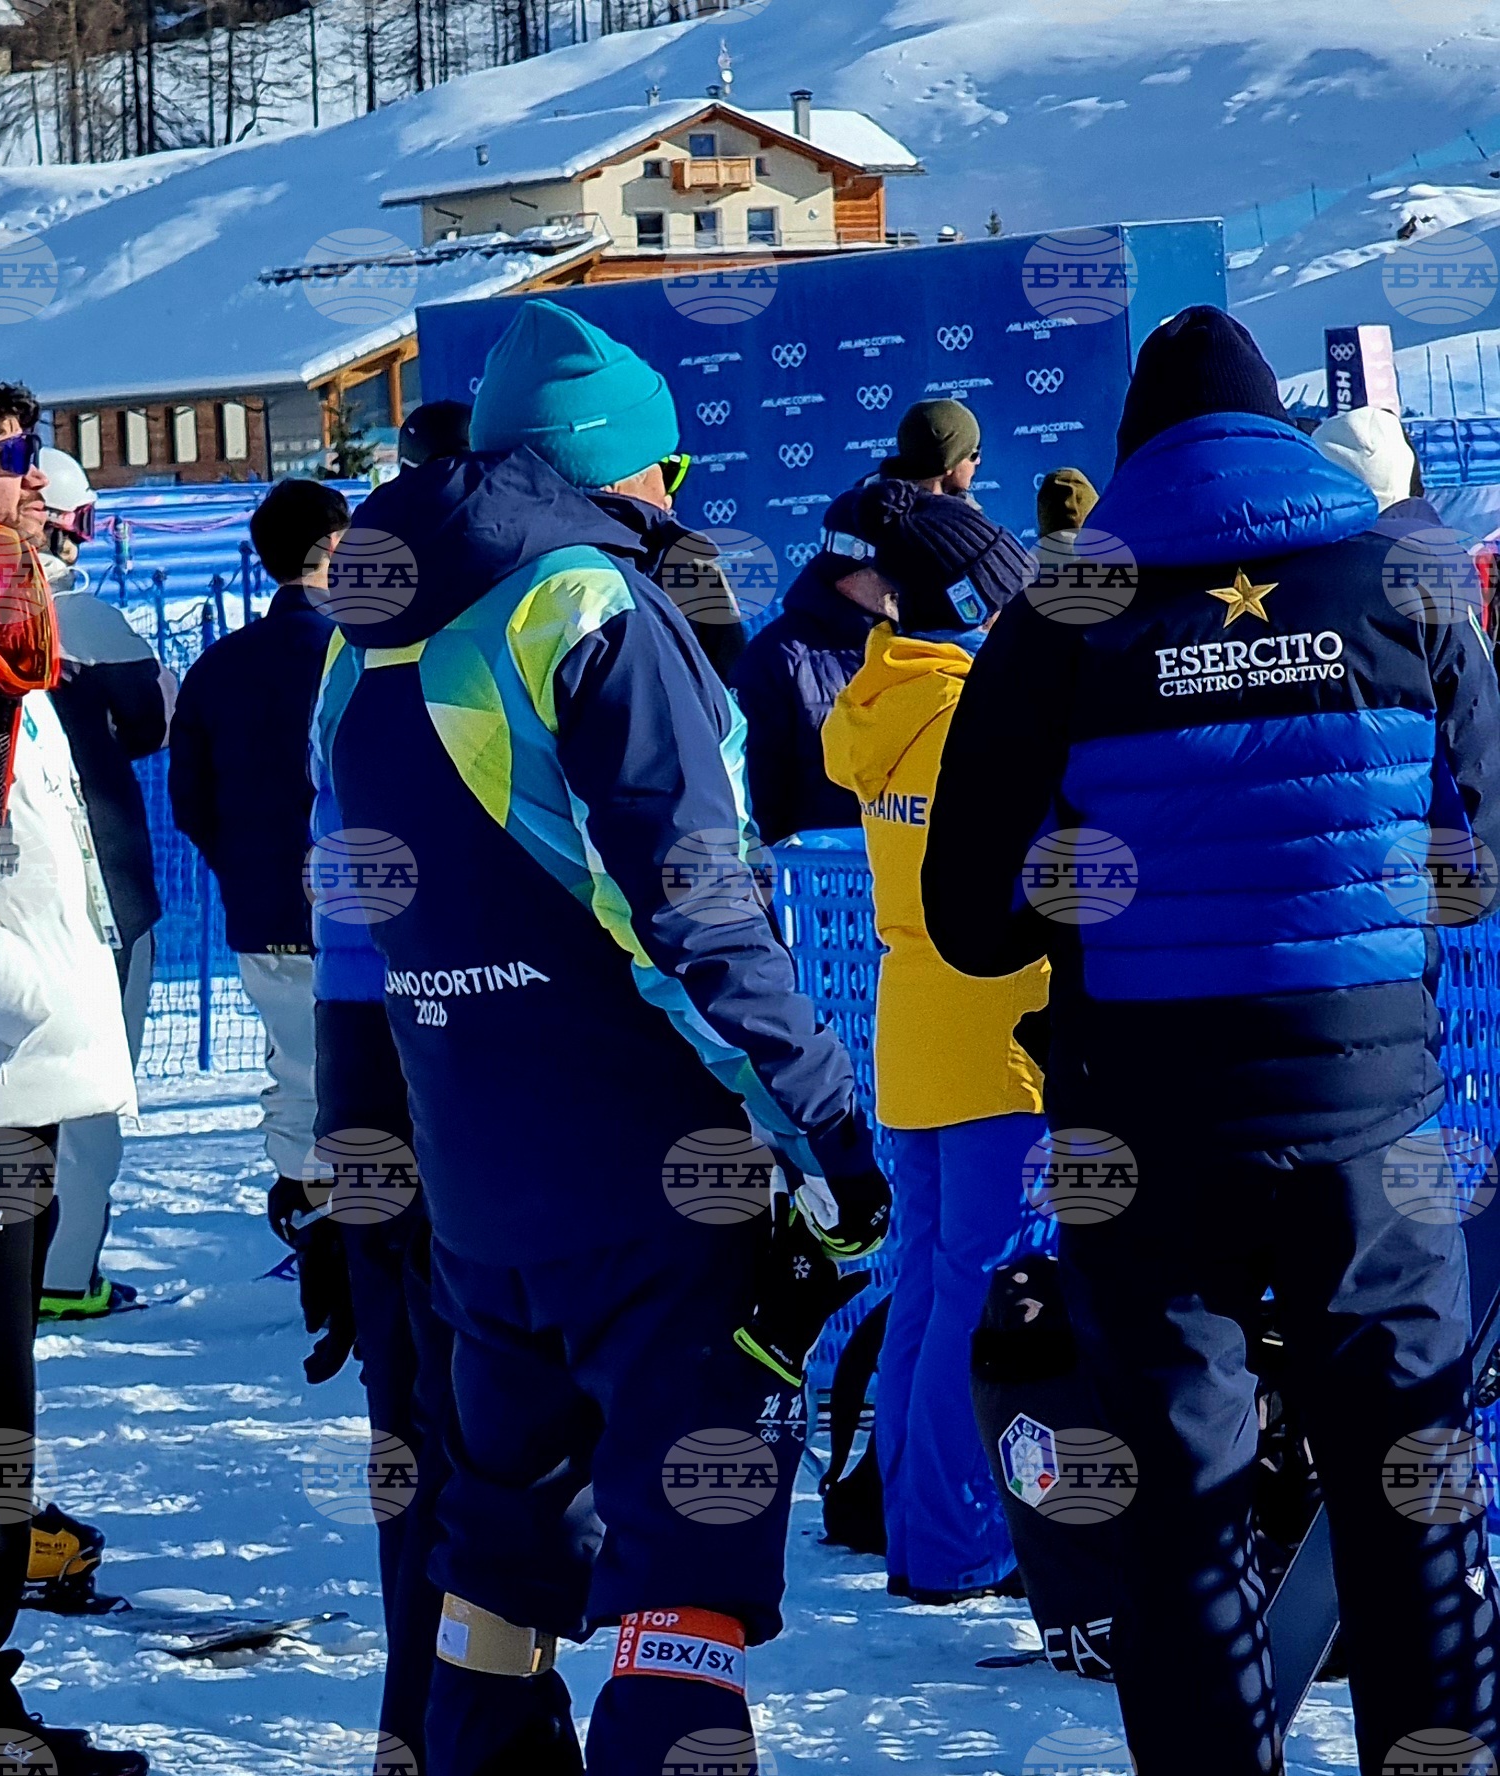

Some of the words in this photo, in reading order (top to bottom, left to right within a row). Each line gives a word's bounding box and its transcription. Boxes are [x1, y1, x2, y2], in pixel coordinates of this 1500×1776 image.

[1155, 631, 1343, 679] ESERCITO
[1159, 674, 1243, 697] CENTRO
[1248, 663, 1345, 687] SPORTIVO
[421, 961, 551, 997] CORTINA
[414, 999, 448, 1027] 2026
[642, 1611, 679, 1627] FOP
[641, 1640, 735, 1675] SBX/SX
